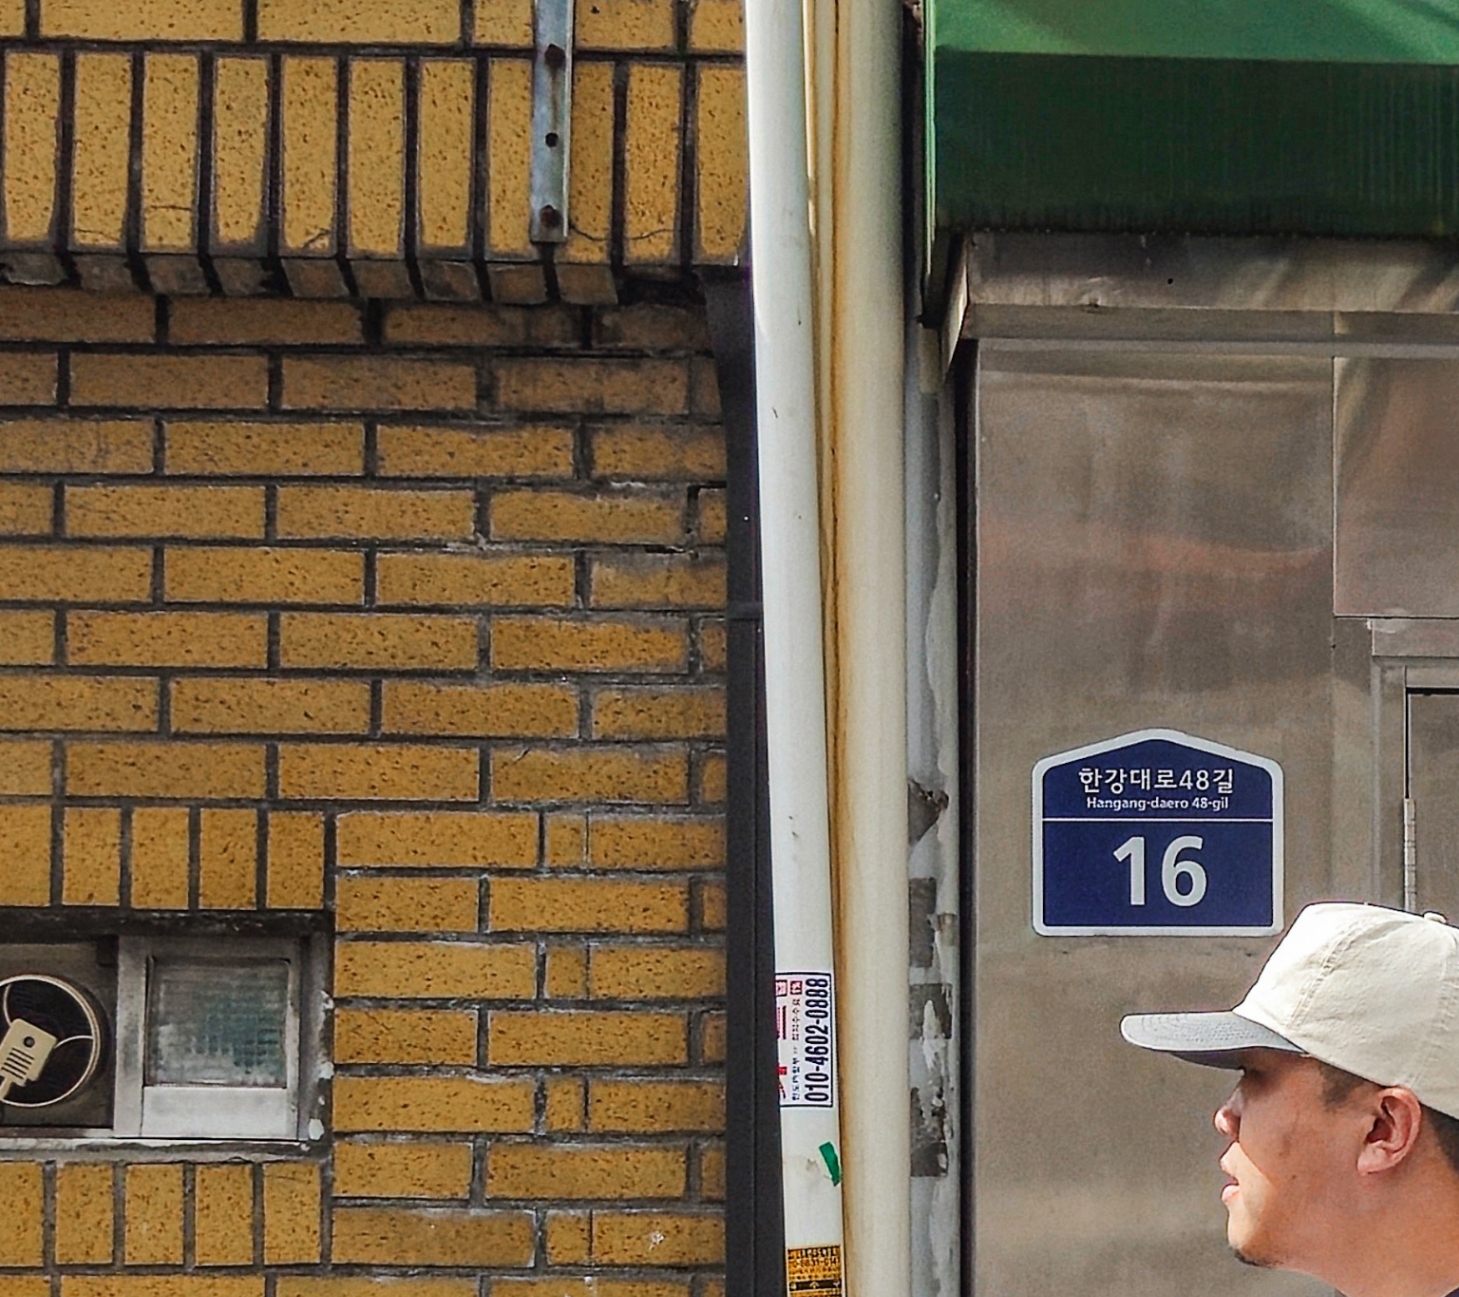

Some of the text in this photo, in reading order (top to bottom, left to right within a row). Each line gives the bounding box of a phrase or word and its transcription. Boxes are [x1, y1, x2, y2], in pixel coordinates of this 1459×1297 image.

[1078, 767, 1235, 795] 한강대로48길
[1086, 796, 1229, 812] Hangang-daero 48-gil
[1112, 834, 1208, 907] 16
[804, 976, 830, 1103] 010-4602-0888
